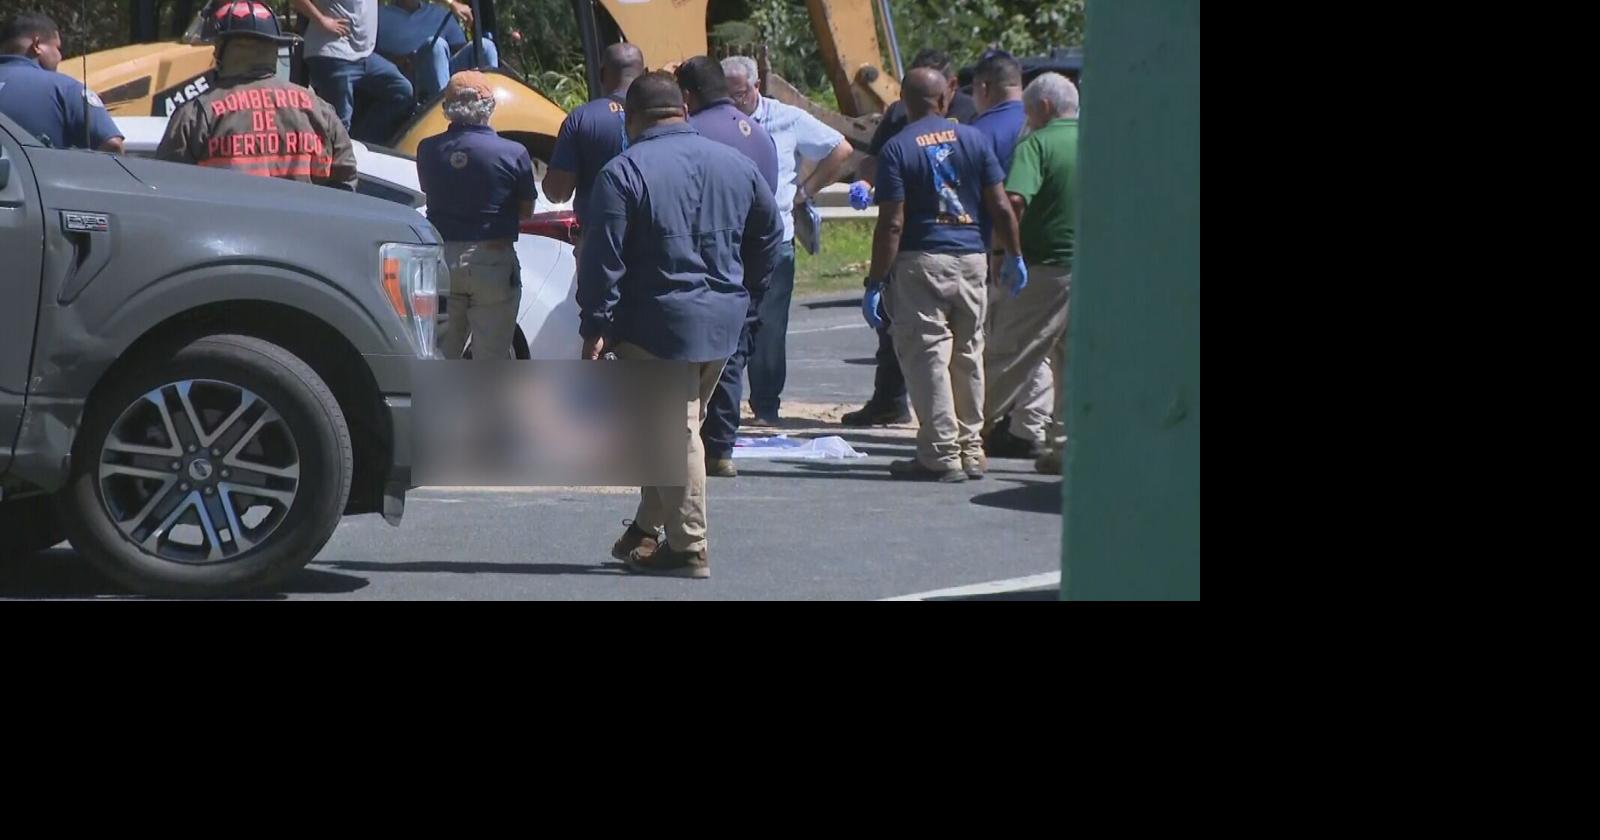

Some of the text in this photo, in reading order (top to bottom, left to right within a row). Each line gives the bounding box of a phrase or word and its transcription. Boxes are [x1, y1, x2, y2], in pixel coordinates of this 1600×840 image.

[212, 88, 313, 117] BOMBEROS
[252, 110, 277, 132] DE
[208, 132, 323, 157] PUERTO RICO
